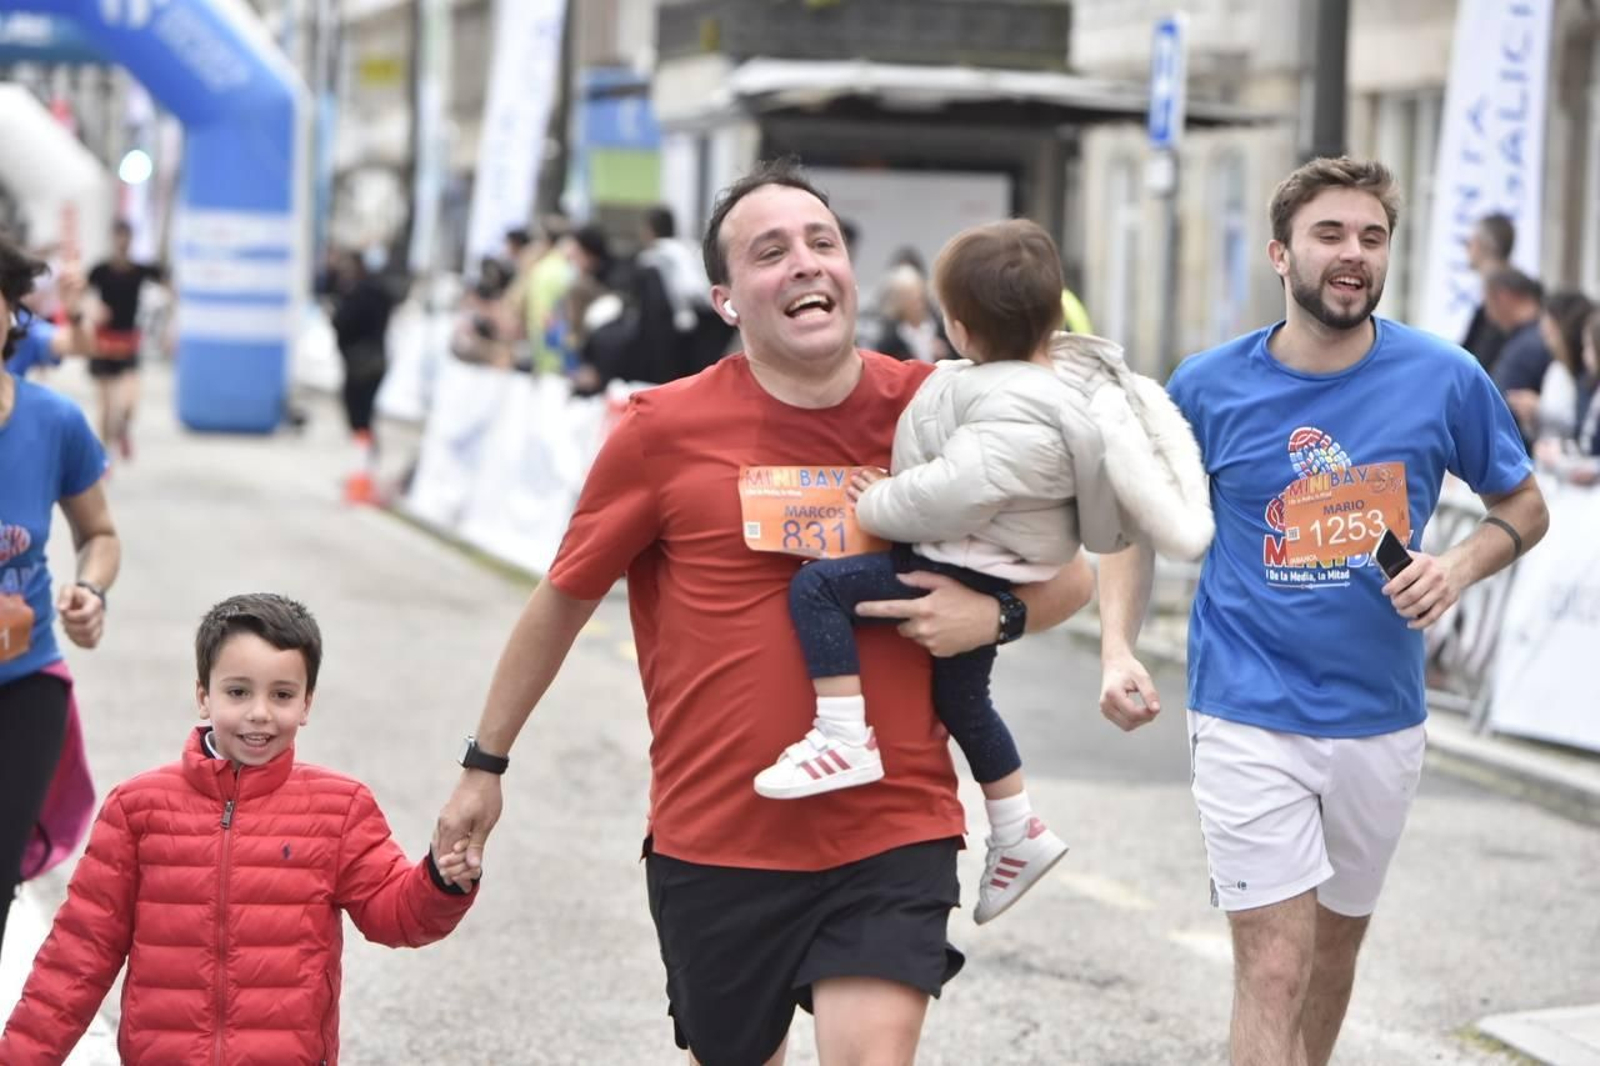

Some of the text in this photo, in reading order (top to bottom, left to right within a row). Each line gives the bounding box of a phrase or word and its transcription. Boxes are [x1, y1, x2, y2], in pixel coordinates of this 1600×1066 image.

[785, 505, 846, 519] MARCOS
[1323, 499, 1365, 515] MARIO
[783, 519, 847, 553] 831
[1310, 510, 1385, 547] 1253
